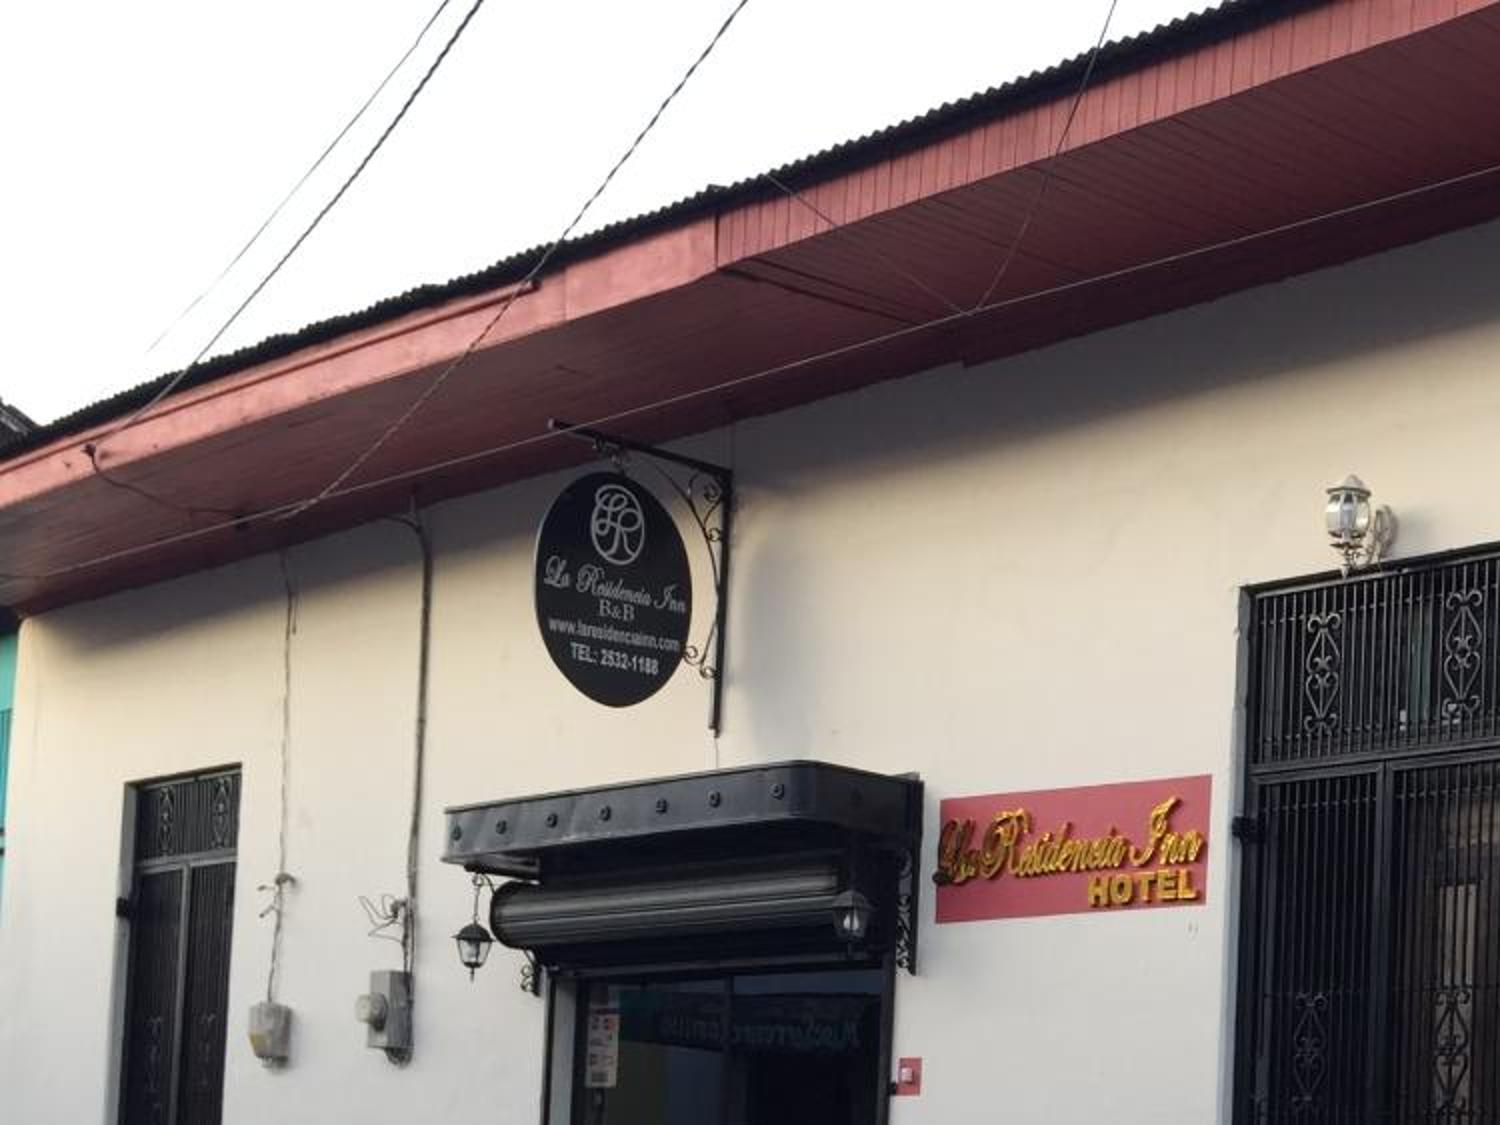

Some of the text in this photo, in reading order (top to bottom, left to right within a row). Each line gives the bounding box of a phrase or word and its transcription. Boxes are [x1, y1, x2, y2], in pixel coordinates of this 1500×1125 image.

[546, 555, 686, 613] La Residencia Inn
[599, 599, 635, 621] B&B
[570, 642, 659, 675] TEL: 2532-1188
[938, 796, 1206, 886] La Residencia Inn
[1088, 869, 1200, 907] HOTEL
